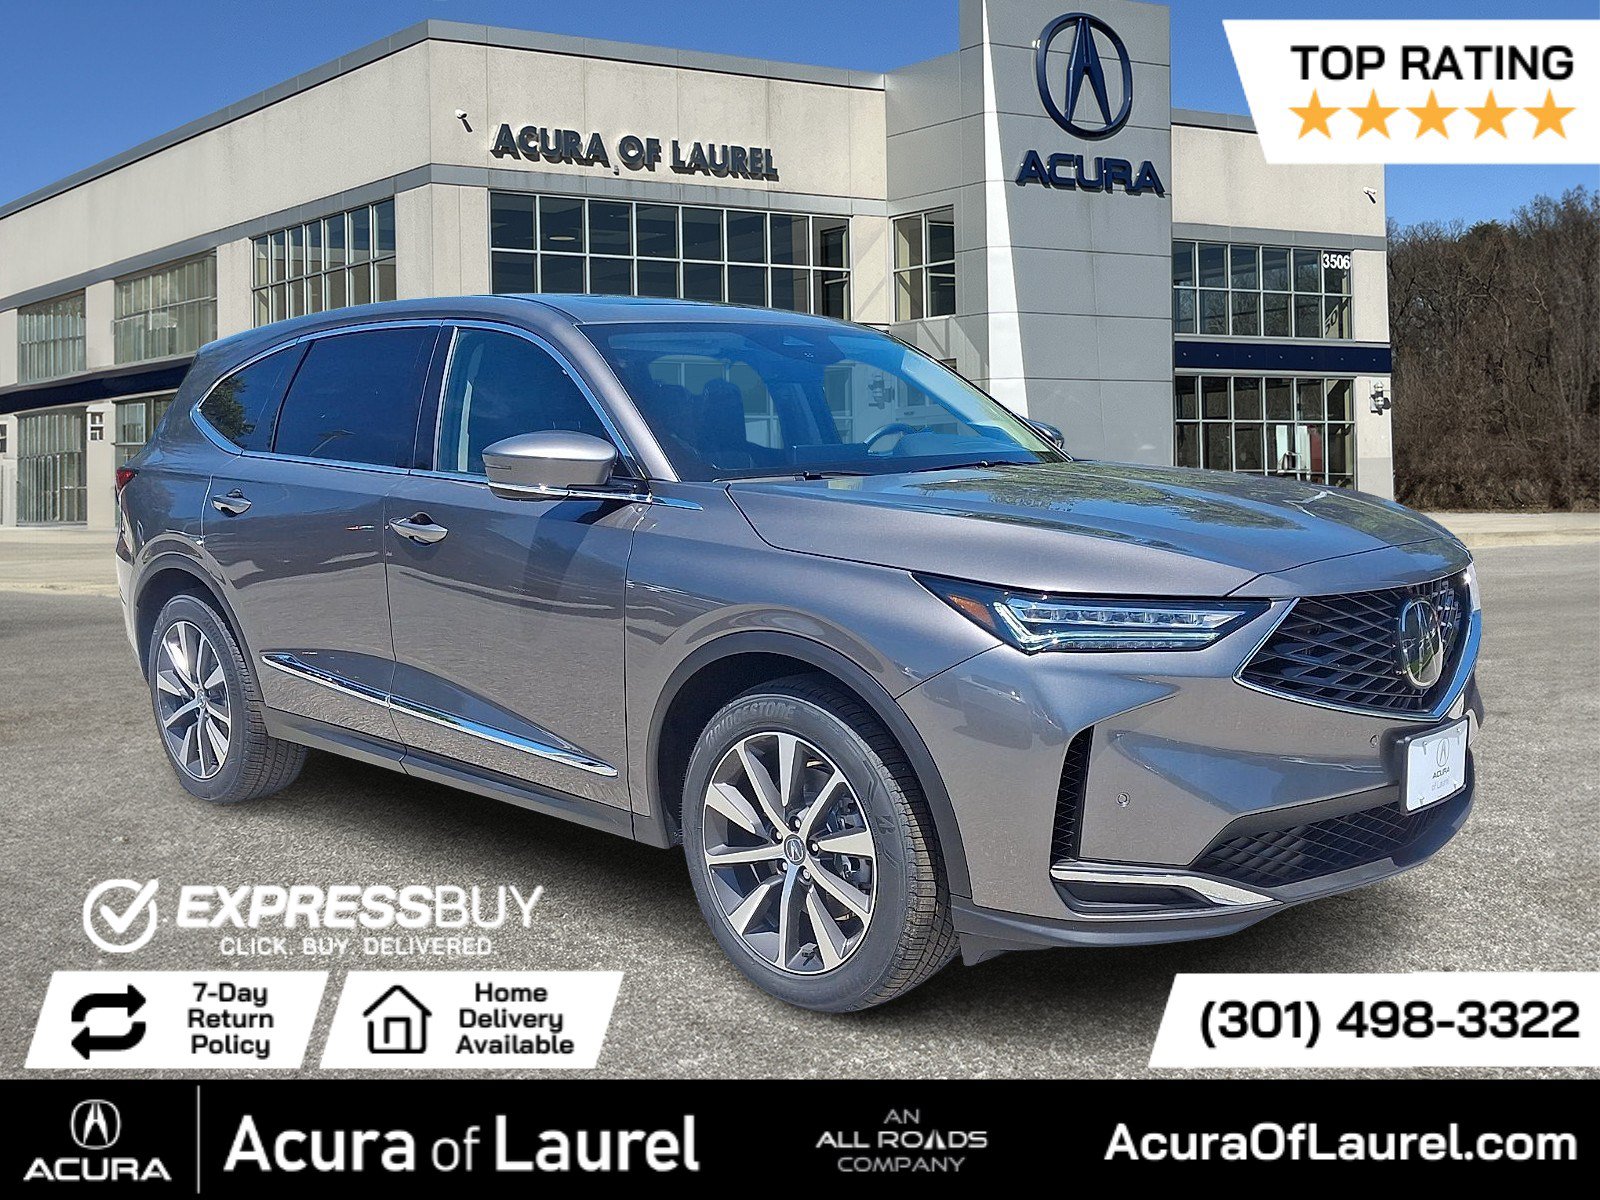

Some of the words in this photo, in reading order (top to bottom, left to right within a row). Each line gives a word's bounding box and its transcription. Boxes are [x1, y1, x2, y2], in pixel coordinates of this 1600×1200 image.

[490, 123, 610, 167] ACURA
[617, 134, 662, 171] OF
[670, 139, 779, 182] LAUREL
[1015, 149, 1166, 198] ACURA
[1322, 253, 1351, 270] 3506
